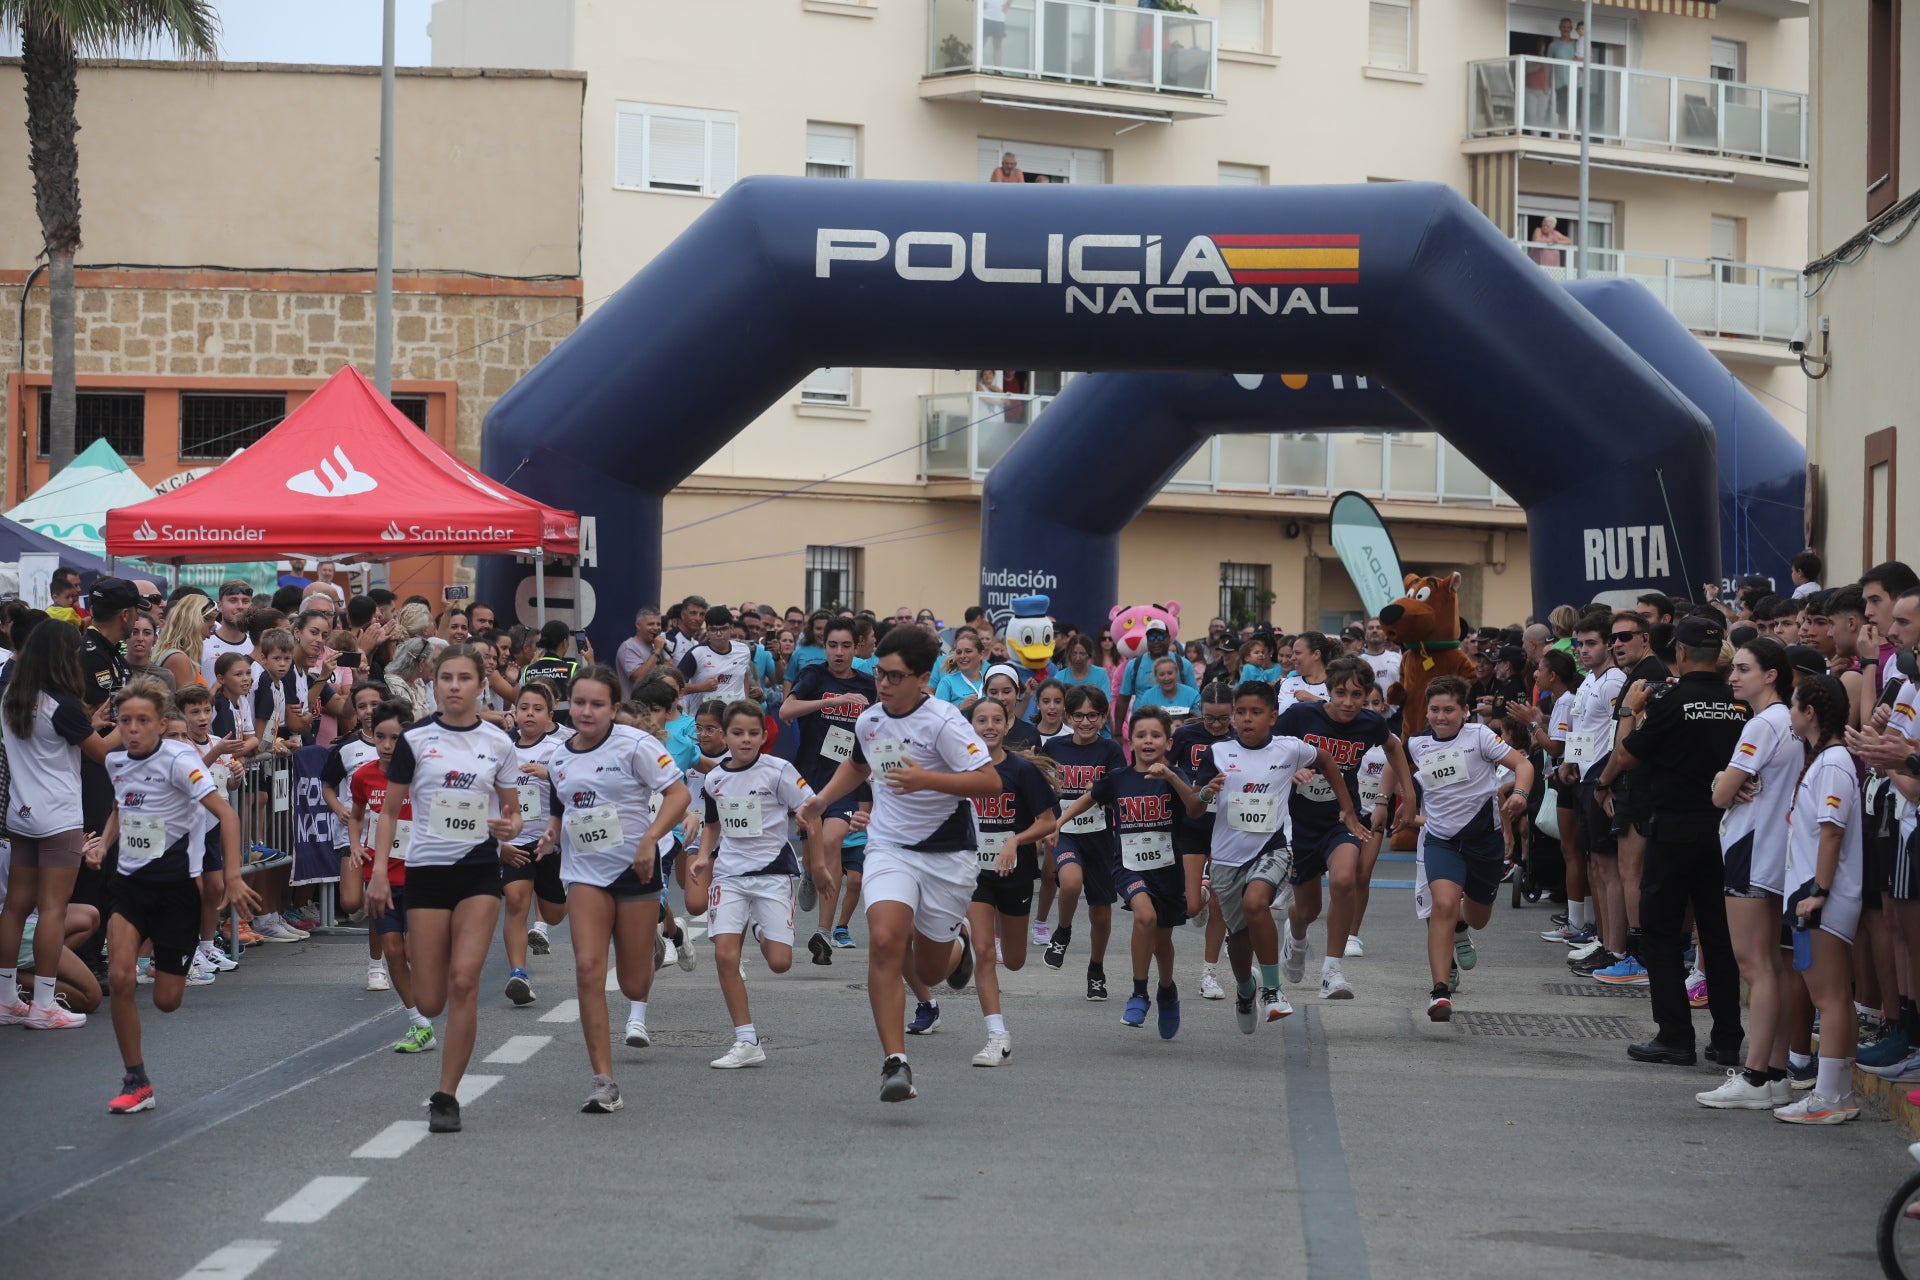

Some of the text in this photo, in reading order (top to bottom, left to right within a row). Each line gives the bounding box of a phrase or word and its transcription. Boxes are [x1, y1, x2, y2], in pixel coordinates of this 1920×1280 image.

[1065, 286, 1358, 315] NACIONAL
[161, 525, 266, 541] Santander
[409, 526, 515, 541] Santander
[1583, 525, 1670, 581] RUTA
[982, 567, 1057, 589] fundación
[988, 589, 1035, 611] mup
[1684, 711, 1747, 721] NACIONAL
[833, 745, 852, 757] 1081
[1574, 748, 1582, 756] 78
[1431, 766, 1456, 779] 1023
[1308, 785, 1332, 795] 1072
[1361, 791, 1378, 800] 109
[970, 793, 1016, 818] NBC
[1117, 793, 1173, 822] CNBC
[444, 817, 476, 830] 1096
[724, 817, 748, 828] 1106
[1072, 815, 1094, 826] 1084
[1239, 812, 1267, 823] 1007
[127, 836, 150, 848] 1005
[579, 829, 608, 843] 1052
[1135, 850, 1161, 862] 1085
